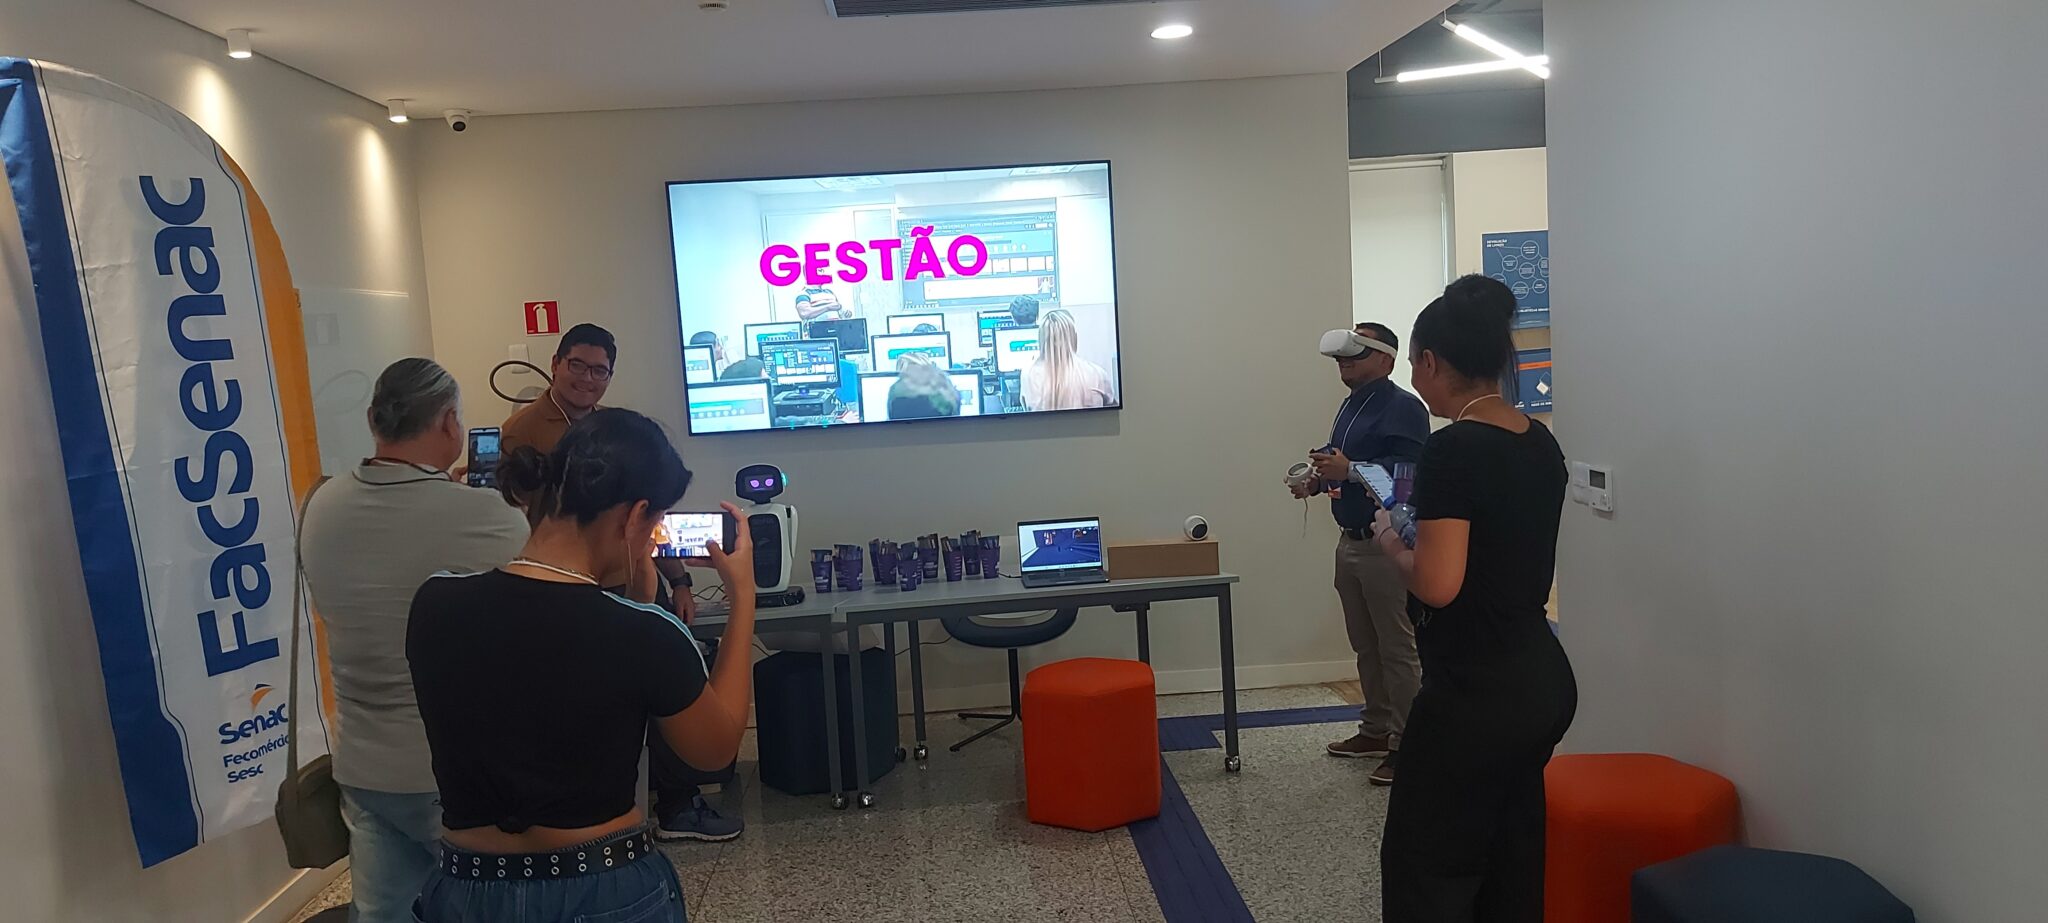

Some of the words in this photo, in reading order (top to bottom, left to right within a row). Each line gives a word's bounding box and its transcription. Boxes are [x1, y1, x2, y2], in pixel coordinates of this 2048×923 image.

[760, 225, 988, 286] GESTÃO
[139, 174, 281, 678] FacSenac
[219, 703, 288, 744] Senac
[227, 764, 264, 783] Sesc
